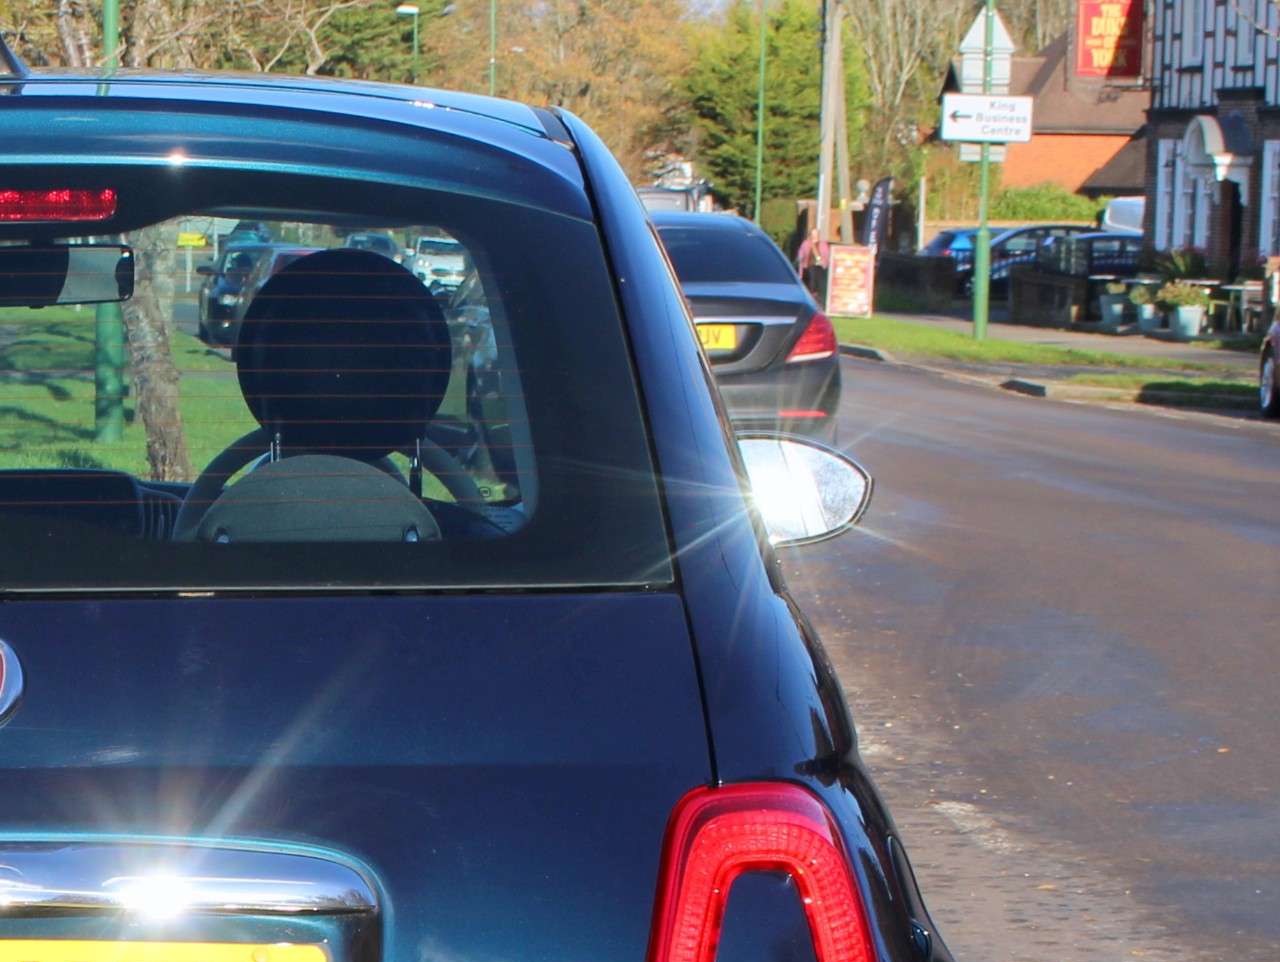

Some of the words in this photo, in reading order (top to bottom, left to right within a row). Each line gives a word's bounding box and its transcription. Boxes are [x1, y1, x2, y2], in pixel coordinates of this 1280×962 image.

[1100, 4, 1121, 17] THE
[1091, 48, 1127, 67] YORK
[989, 101, 1016, 112] King
[975, 112, 1027, 123] Business
[981, 125, 1021, 136] Centre
